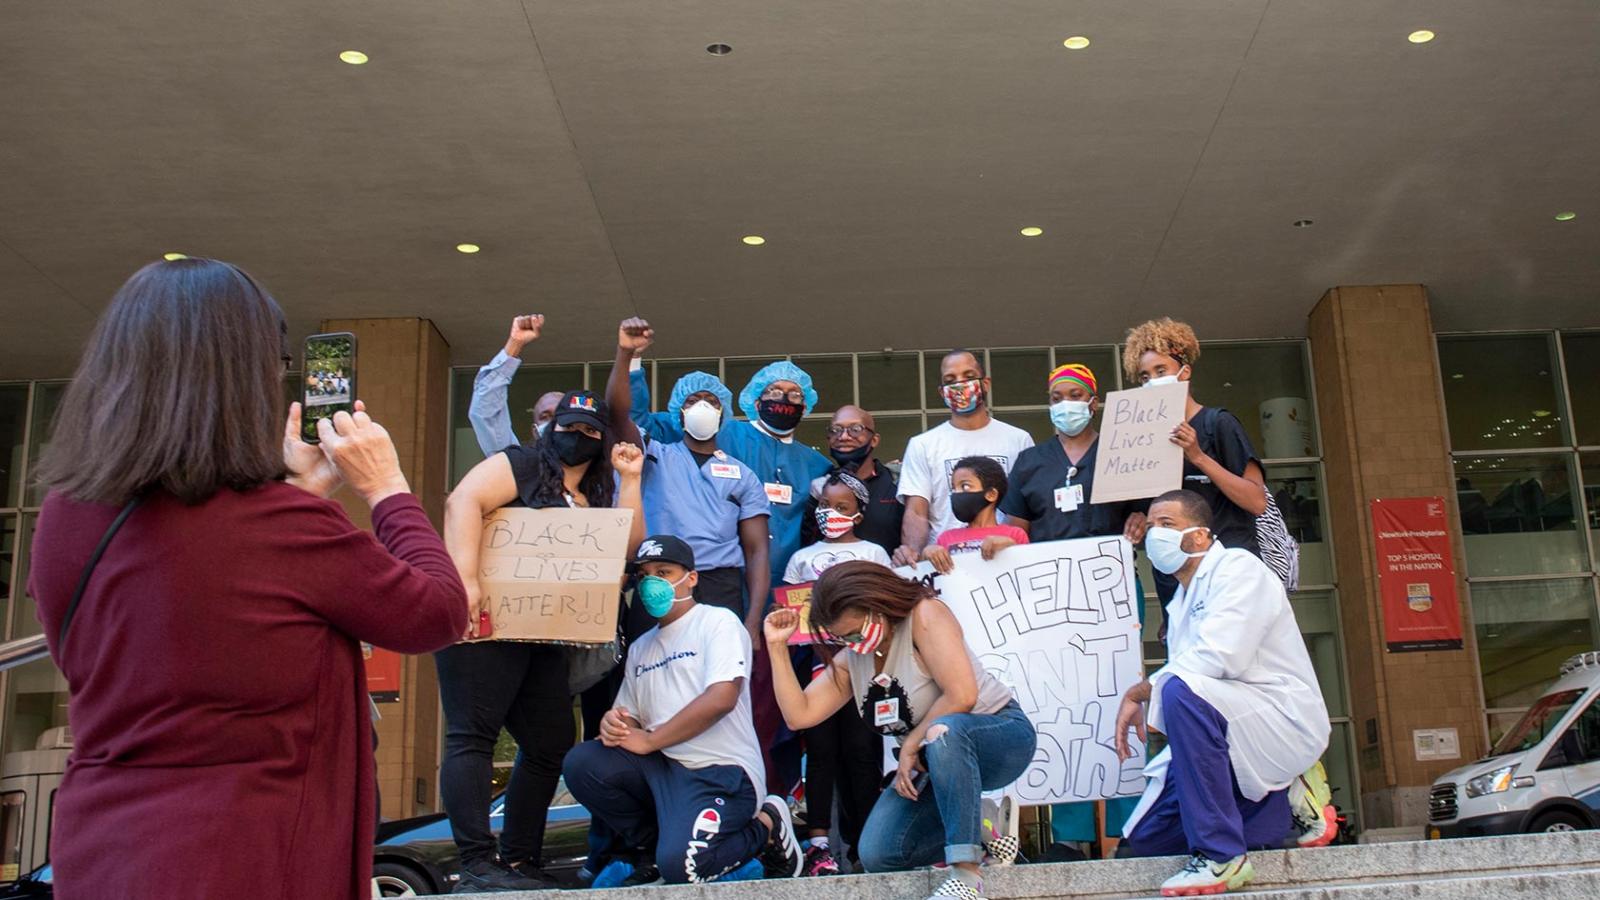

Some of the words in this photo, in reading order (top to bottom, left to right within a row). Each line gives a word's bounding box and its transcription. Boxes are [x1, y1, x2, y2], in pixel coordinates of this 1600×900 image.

[1113, 398, 1168, 425] Black
[1109, 429, 1154, 450] Lives
[1103, 455, 1161, 476] Matter
[484, 519, 604, 552] BLACK
[514, 557, 600, 581] LIVES
[1387, 554, 1401, 562] TOP
[1408, 553, 1442, 561] HOSPITAL
[1400, 563, 1413, 571] THE
[1414, 562, 1442, 570] NATION
[970, 539, 1132, 649] HELP!
[635, 650, 697, 678] Champion
